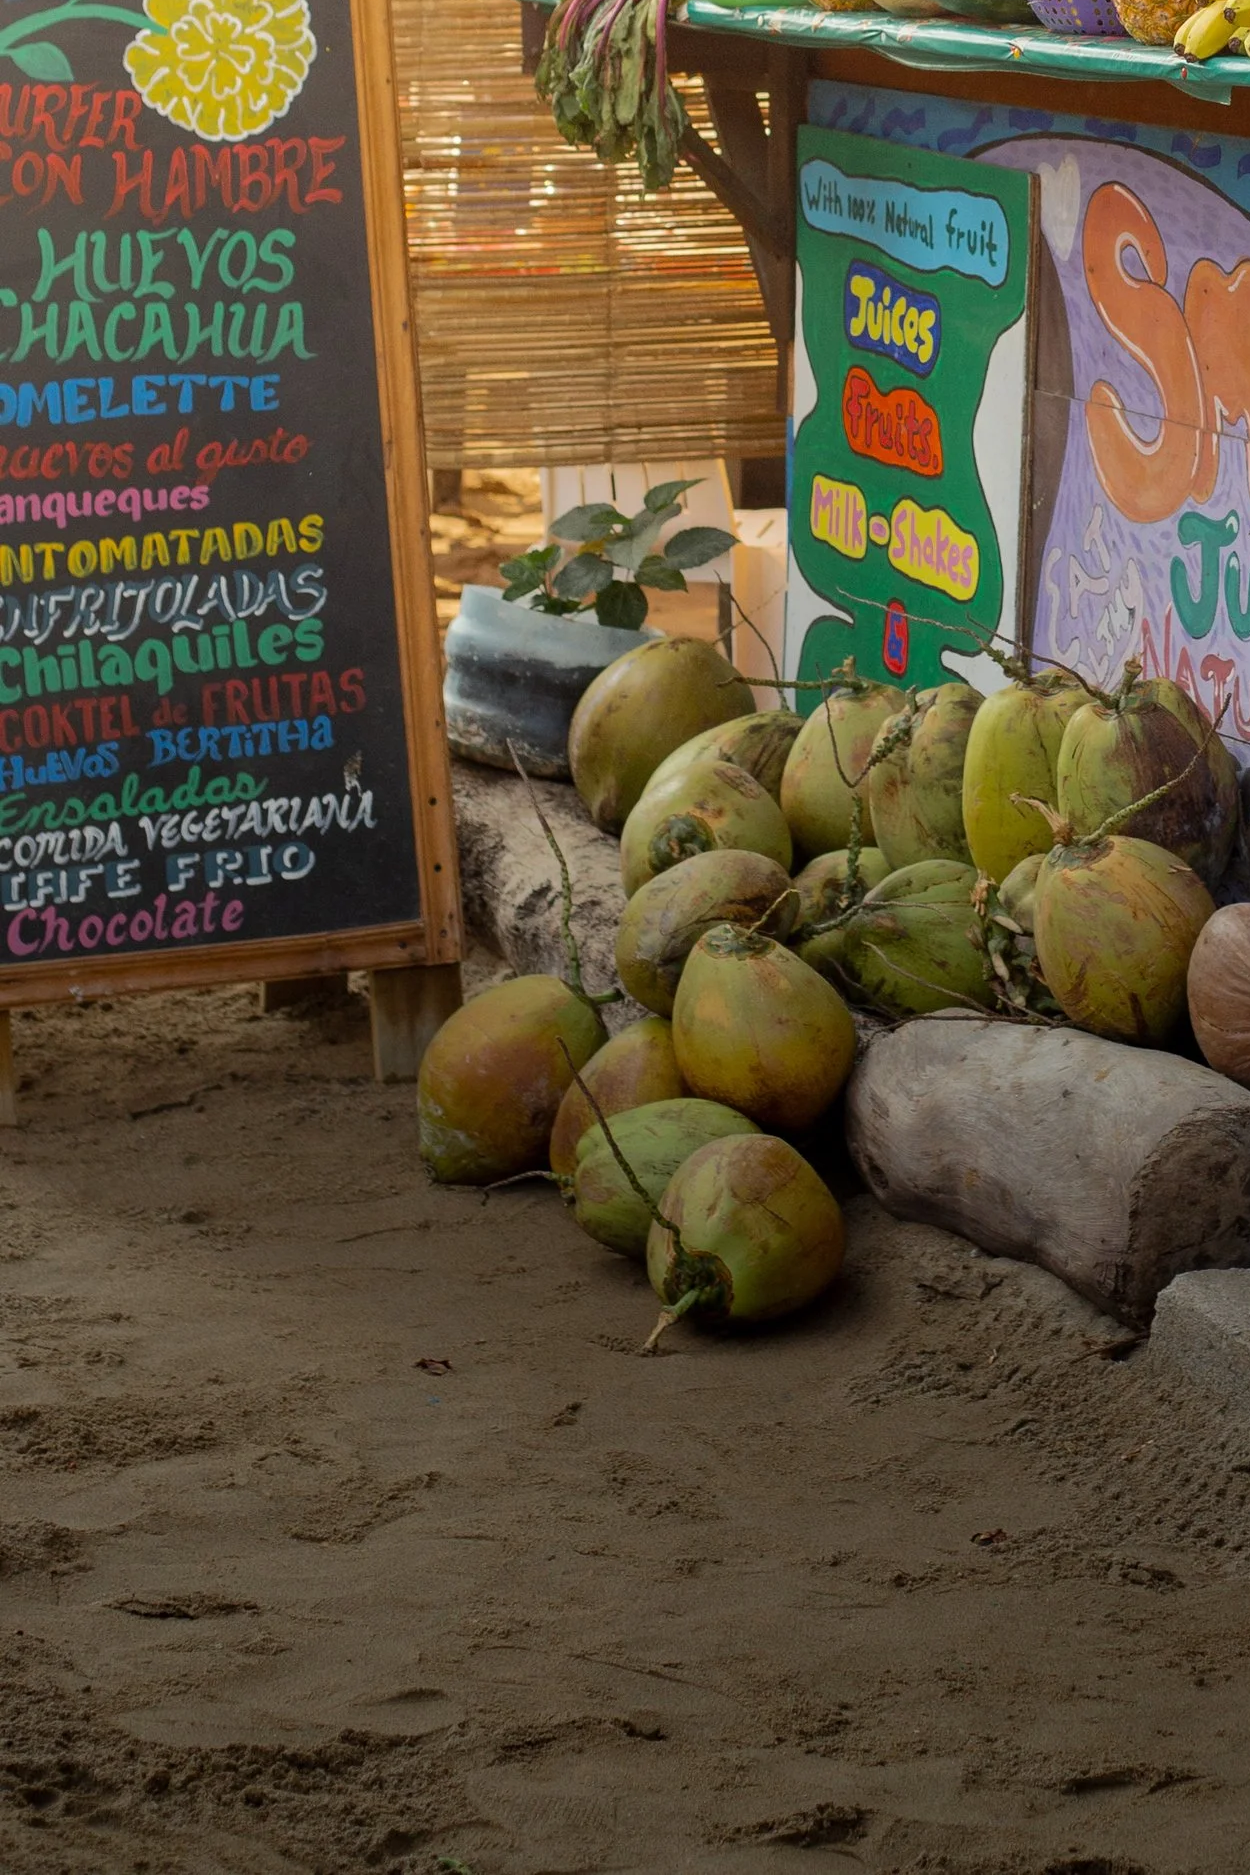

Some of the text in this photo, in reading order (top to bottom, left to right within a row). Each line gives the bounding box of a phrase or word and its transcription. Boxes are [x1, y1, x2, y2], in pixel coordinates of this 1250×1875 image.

[104, 135, 347, 225] HAMBRE
[804, 176, 843, 217] With
[945, 208, 998, 267] fruit
[32, 227, 296, 302] HUEVOS
[849, 274, 935, 364] Juices
[146, 427, 191, 474] al
[196, 427, 312, 488] gusto
[0, 563, 327, 645] NFRIJOLADAS
[0, 616, 325, 704] Chilaquiles
[0, 667, 367, 754] COKTEL de FRUTAS
[0, 765, 269, 834] Ensaladas
[0, 790, 377, 873] COMIDA VEGETARIANA
[1, 841, 315, 912] CAFE FRIO
[7, 890, 244, 956] Chocolate
